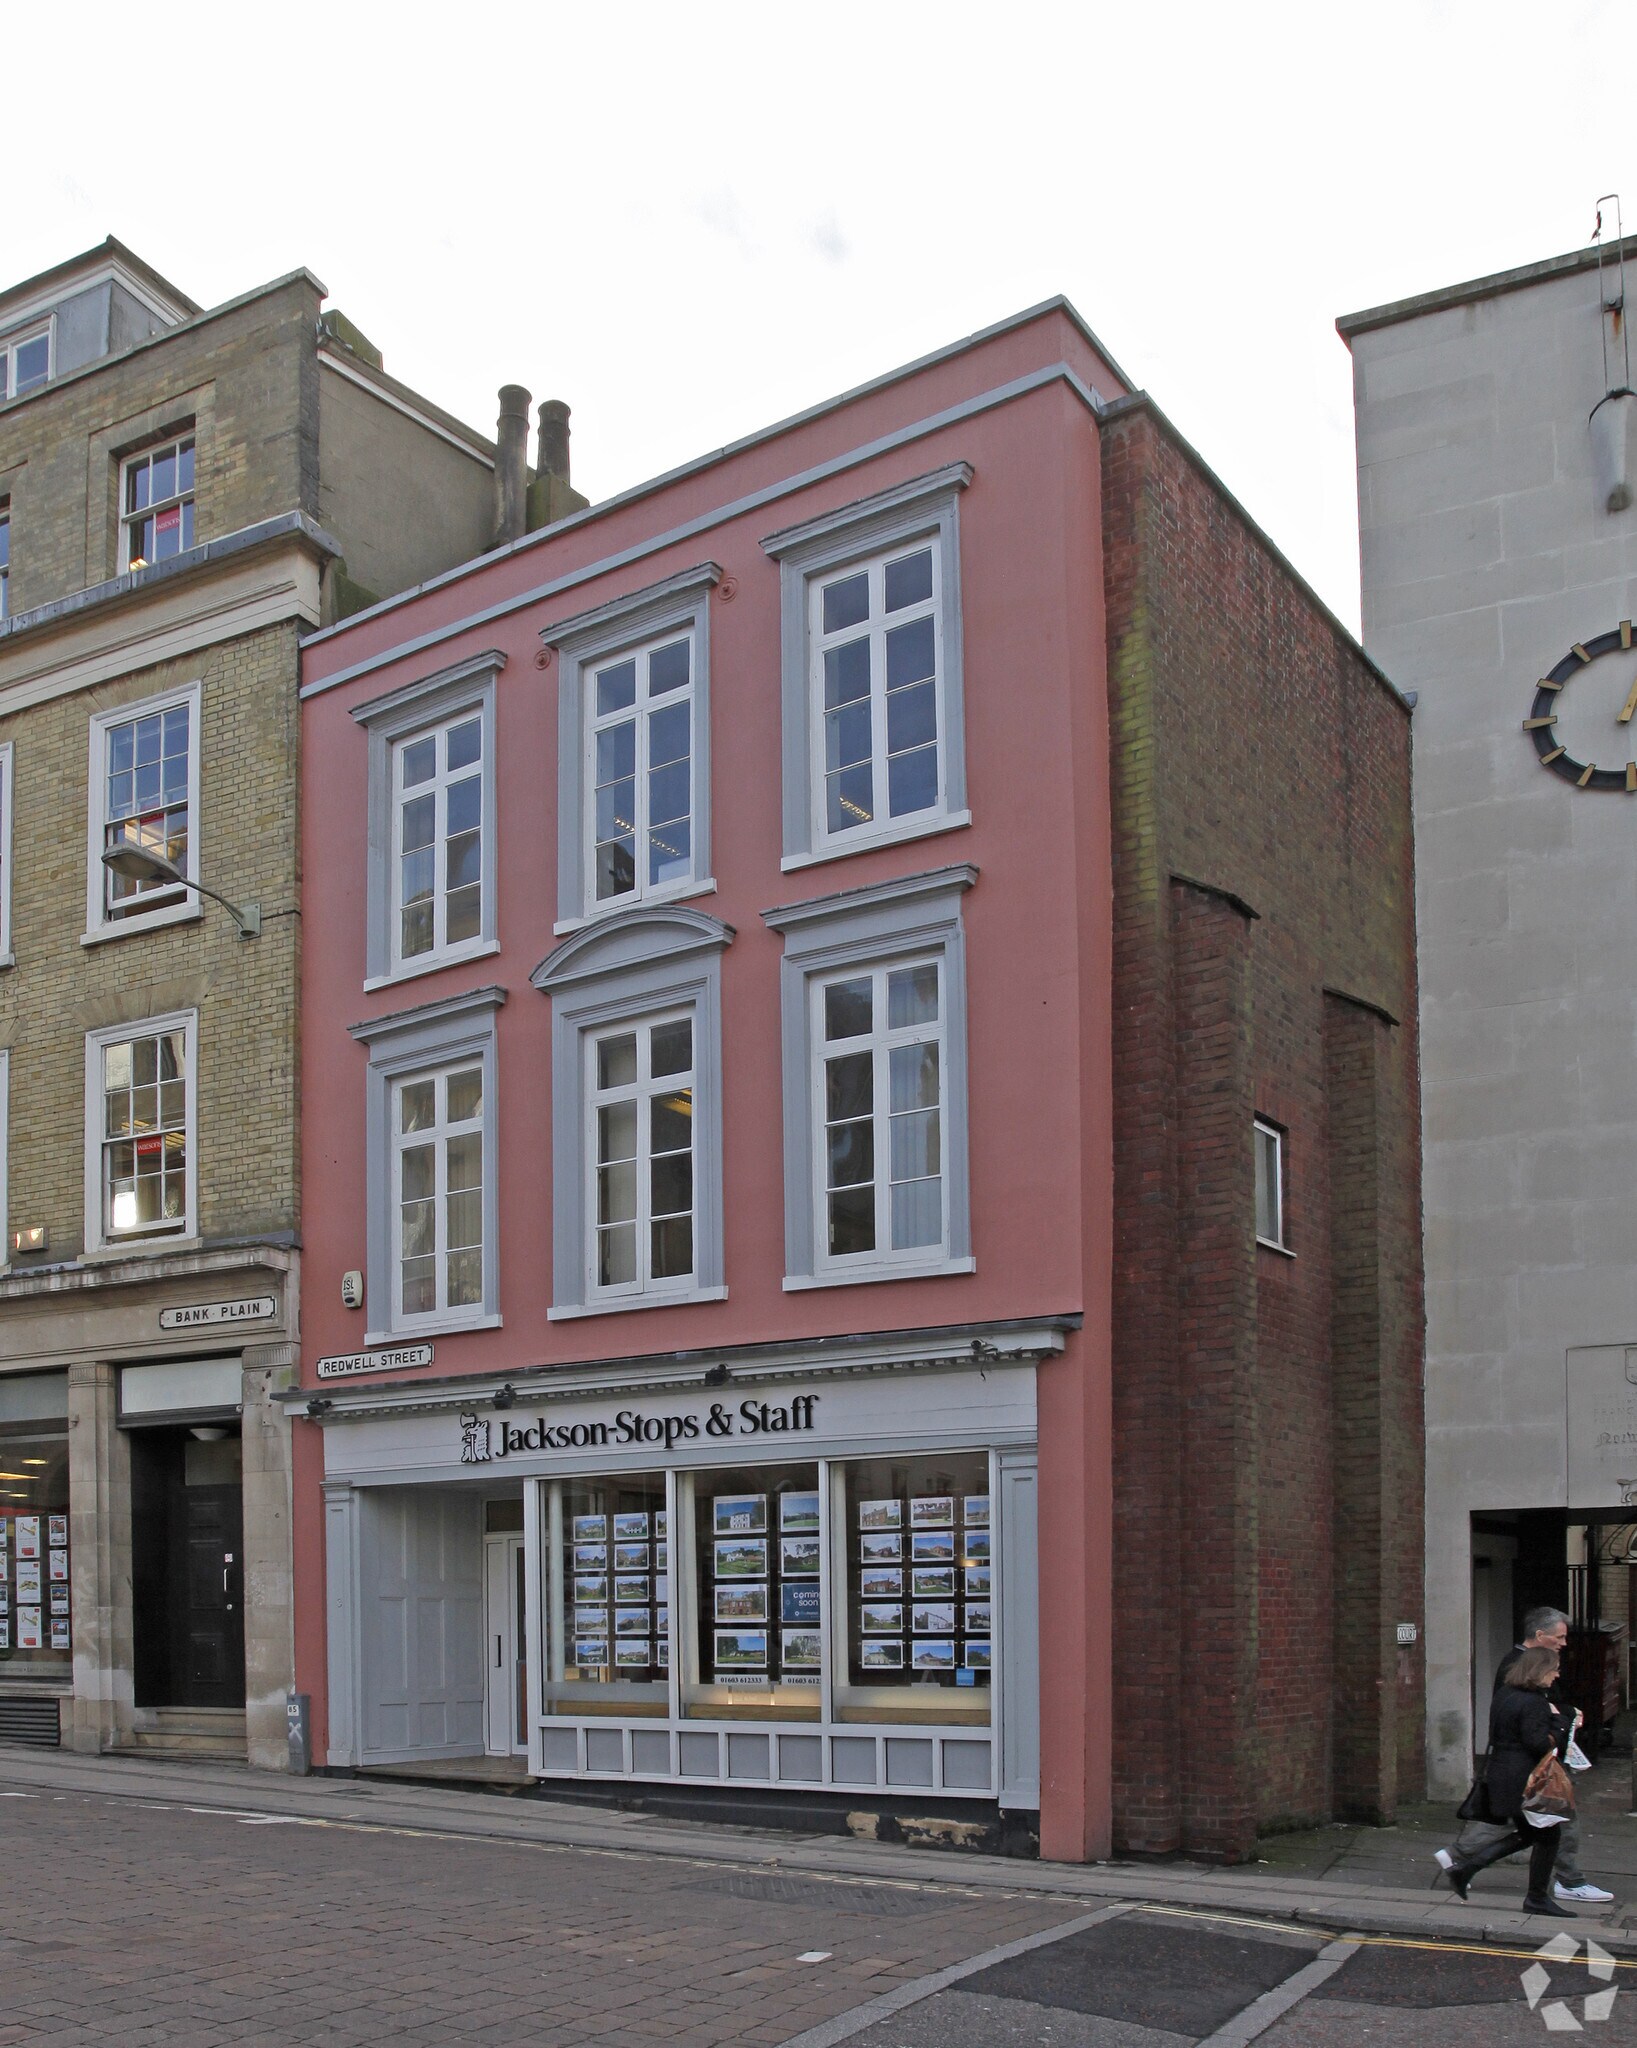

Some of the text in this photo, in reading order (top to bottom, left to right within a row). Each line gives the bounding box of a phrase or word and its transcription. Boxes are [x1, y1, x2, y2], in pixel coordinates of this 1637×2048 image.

[176, 1302, 260, 1323] BANK PLAIN
[323, 1349, 425, 1374] REDWELL STREET
[496, 1393, 819, 1457] Jackson-Stops & Staff
